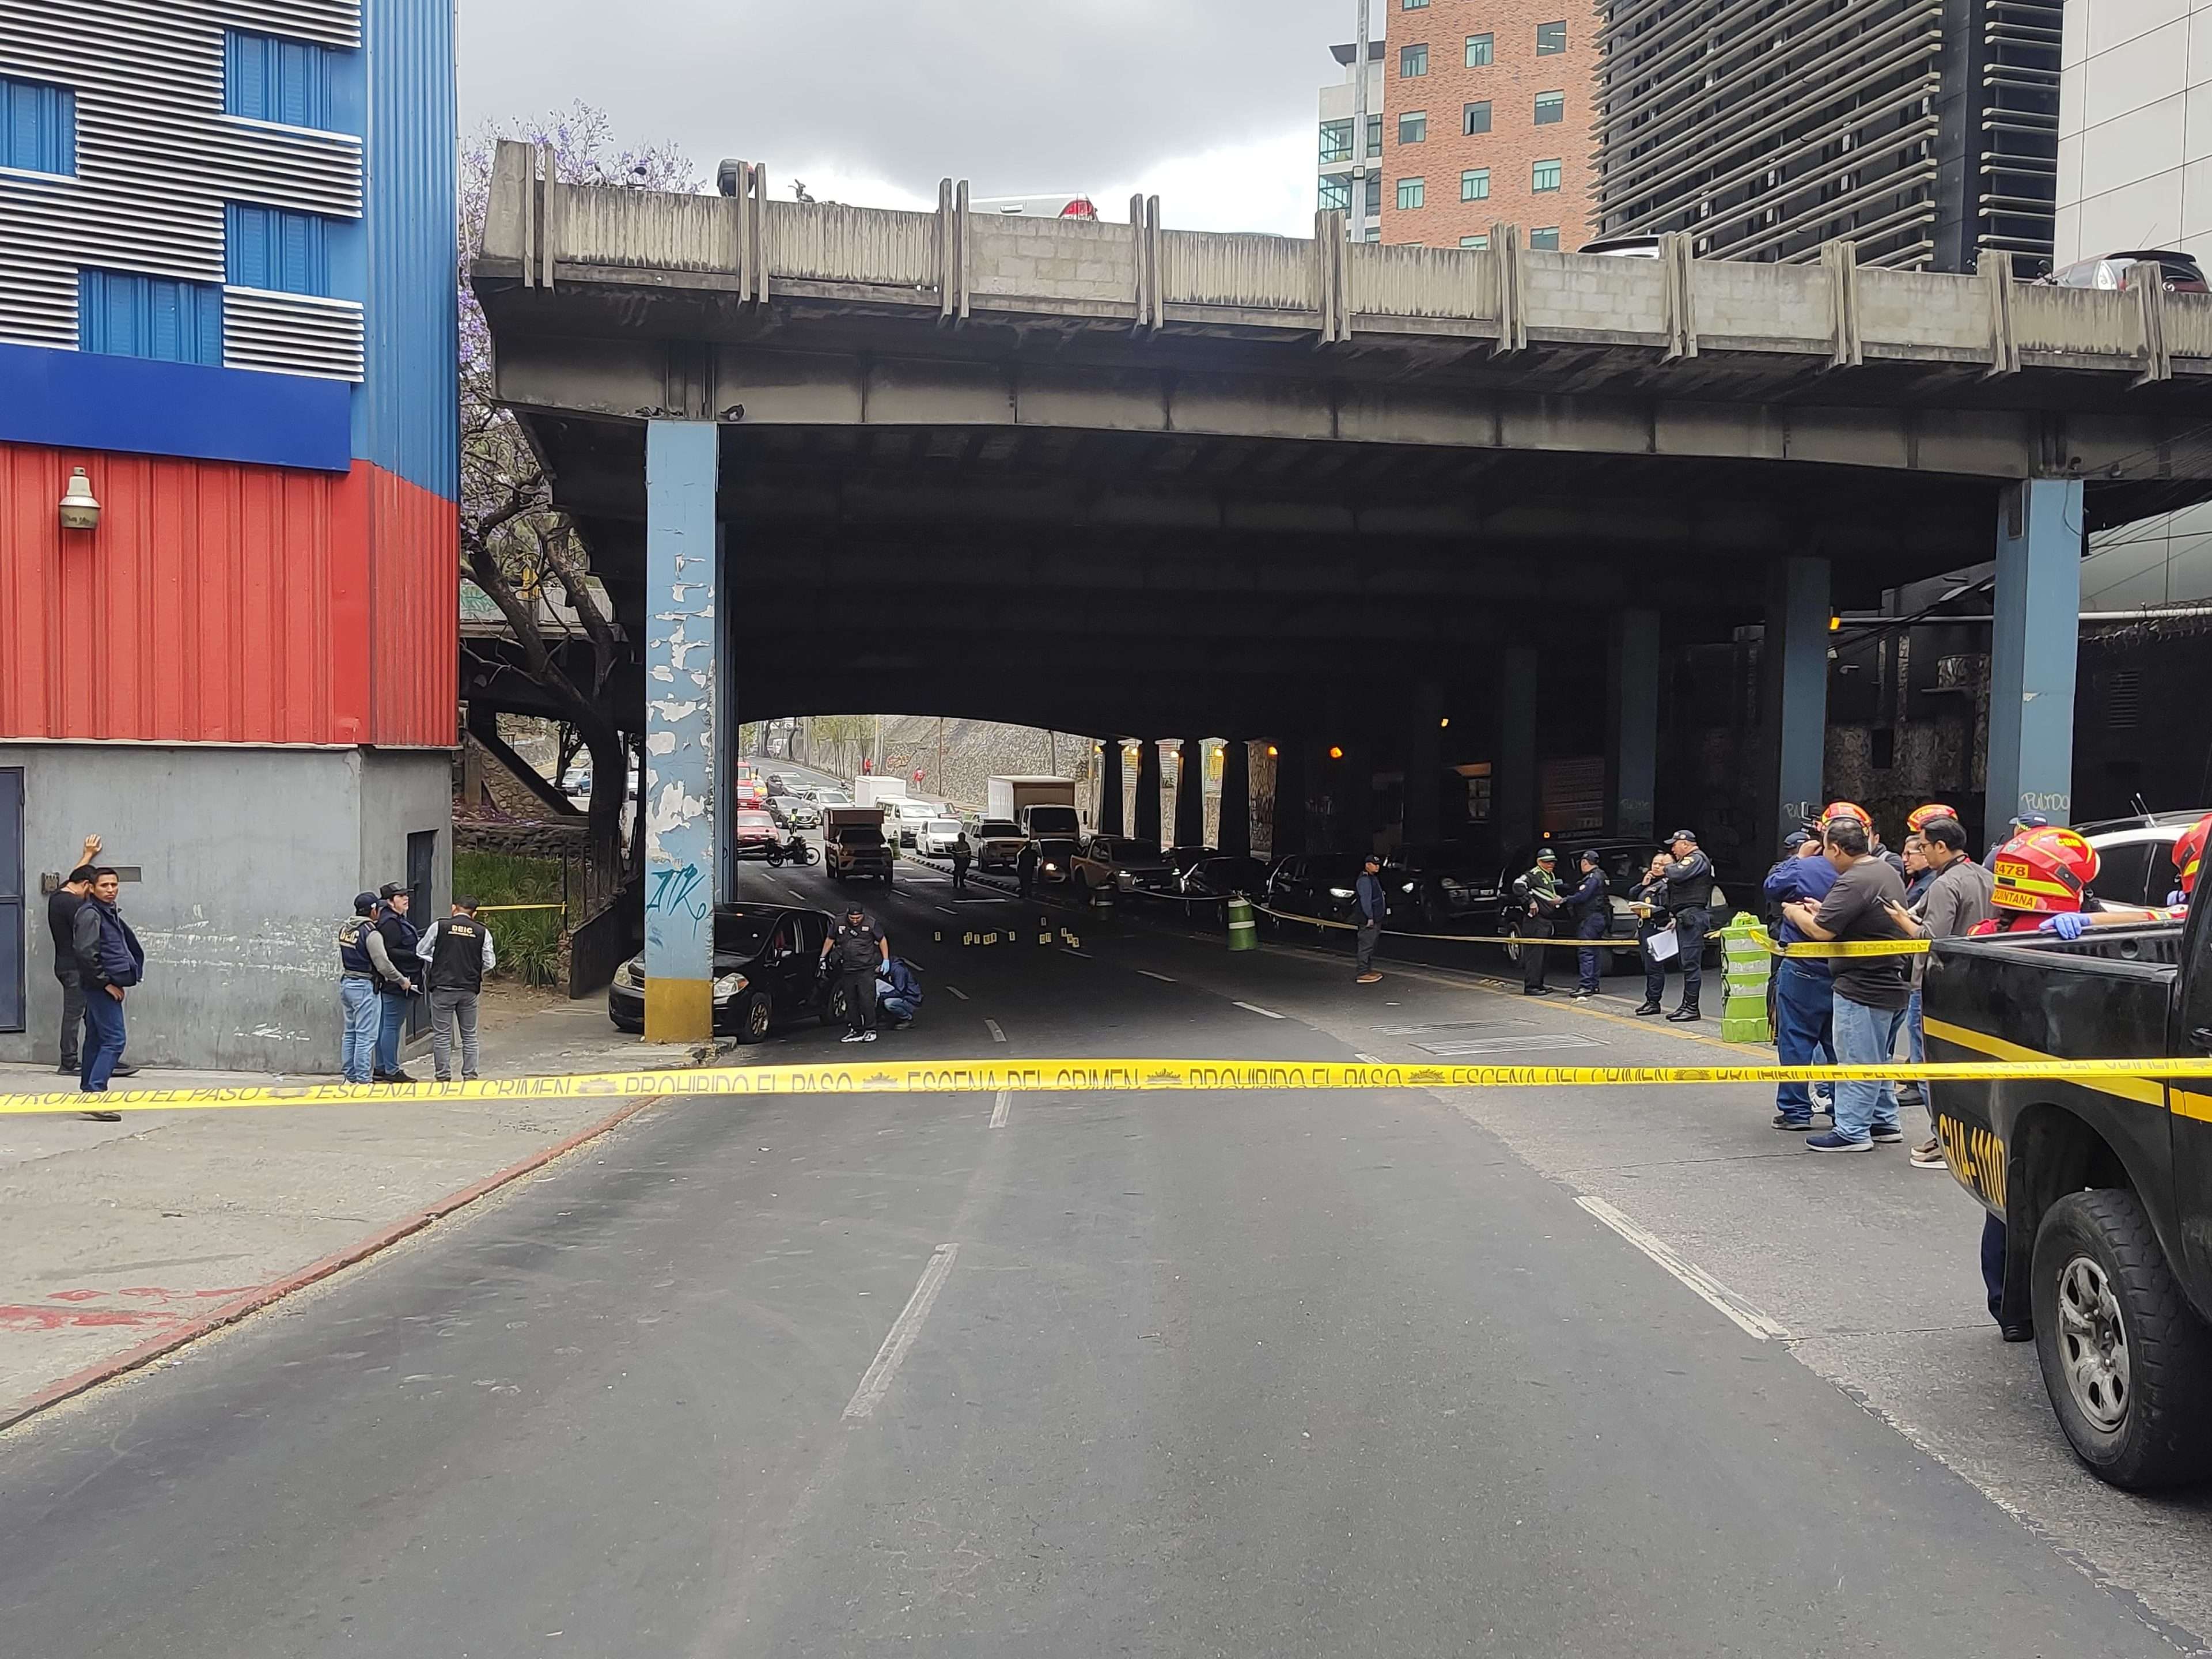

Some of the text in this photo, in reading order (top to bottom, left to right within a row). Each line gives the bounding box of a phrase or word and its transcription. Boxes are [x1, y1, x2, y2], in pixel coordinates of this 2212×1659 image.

[452, 925, 472, 933] DEIC
[5, 1087, 259, 1105] PROHIBIDO EL PASO
[315, 1083, 416, 1099] ESCENA
[480, 1079, 570, 1095] CRIMEN
